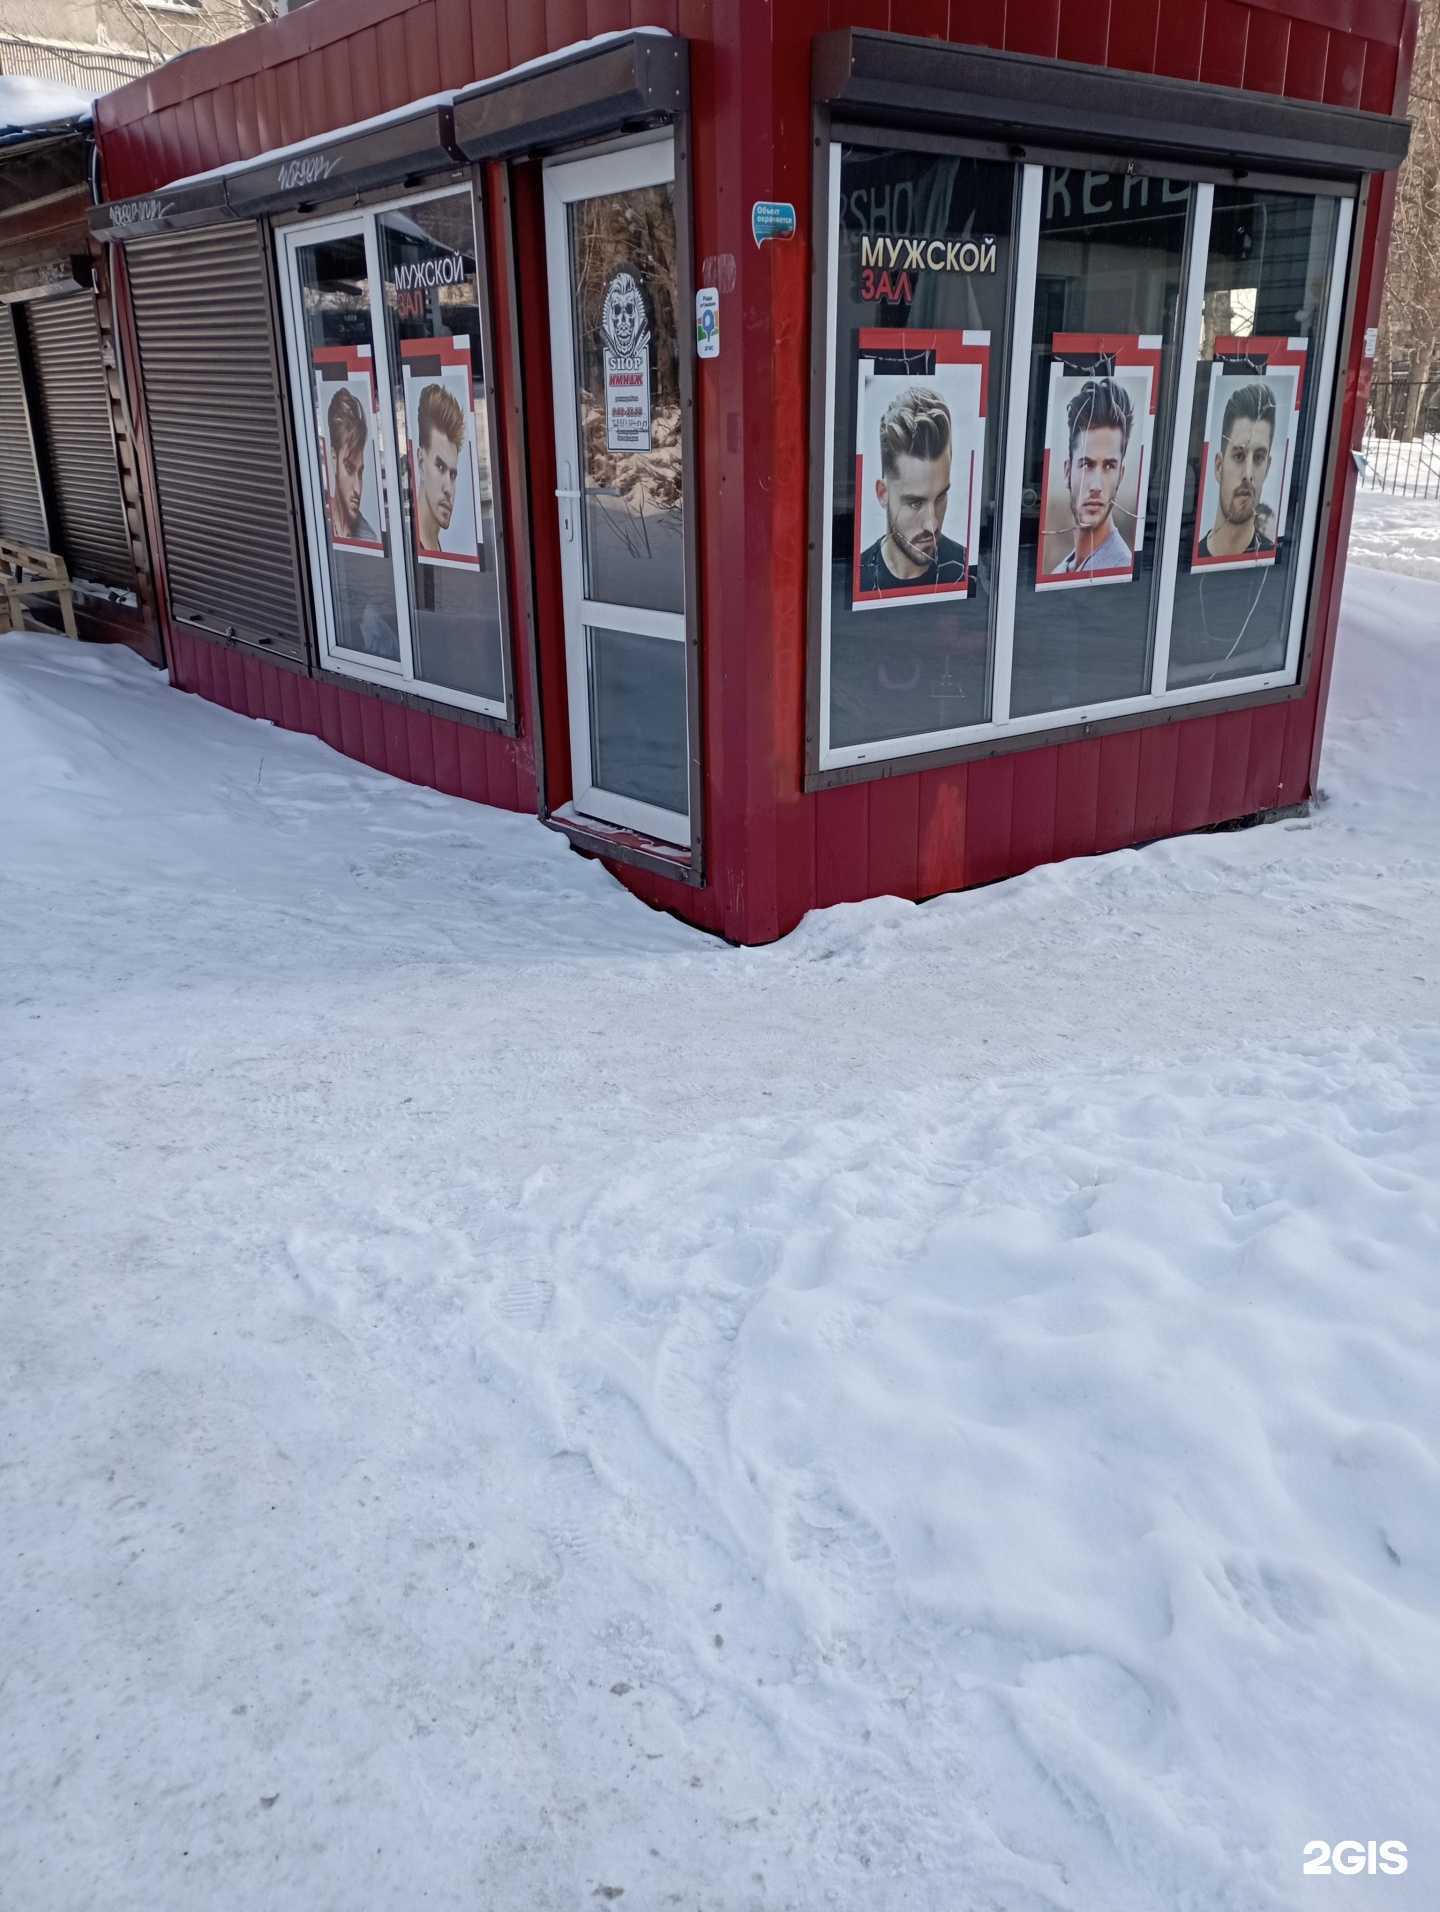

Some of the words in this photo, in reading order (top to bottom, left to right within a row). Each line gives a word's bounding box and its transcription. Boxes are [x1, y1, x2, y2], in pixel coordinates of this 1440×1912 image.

[393, 251, 464, 290] МУЖСКОЙ
[861, 237, 997, 273] МУЖСКОЙ
[861, 269, 913, 303] ЗАЛ
[398, 290, 425, 317] ЗАЛ
[609, 357, 642, 371] SHOP
